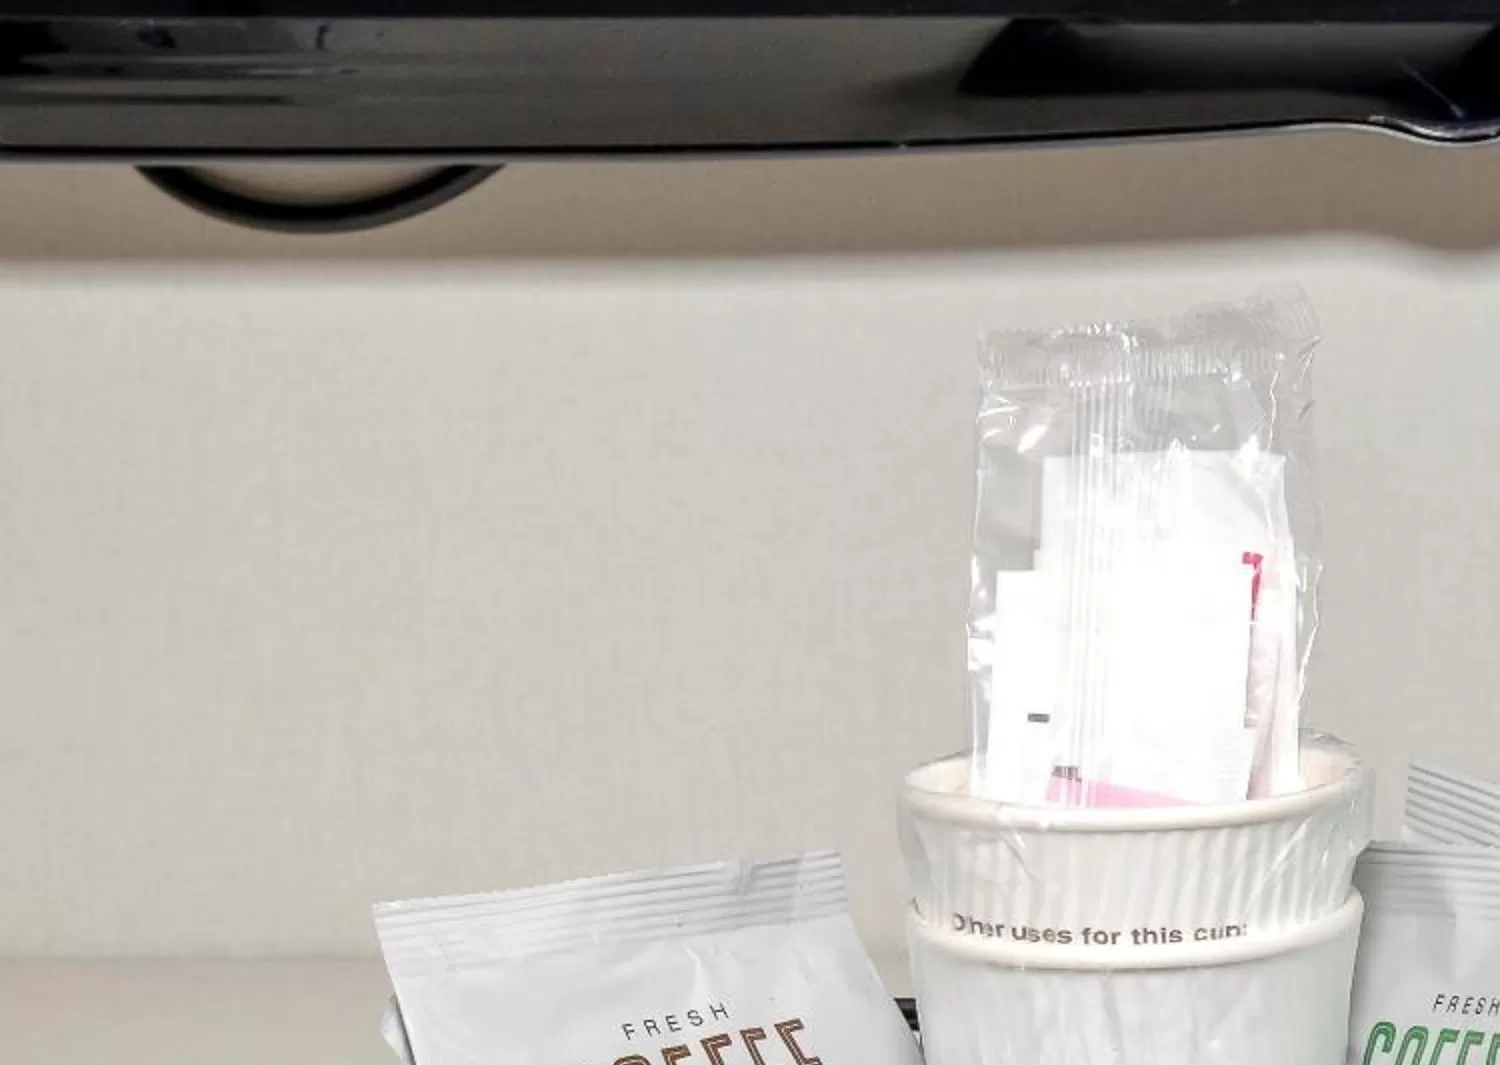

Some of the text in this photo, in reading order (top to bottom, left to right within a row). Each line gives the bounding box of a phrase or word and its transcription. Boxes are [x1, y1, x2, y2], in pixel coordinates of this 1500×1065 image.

[1010, 925, 1073, 945] uses
[1082, 926, 1121, 945] for
[1131, 926, 1183, 945] this
[621, 1002, 729, 1041] FRESH
